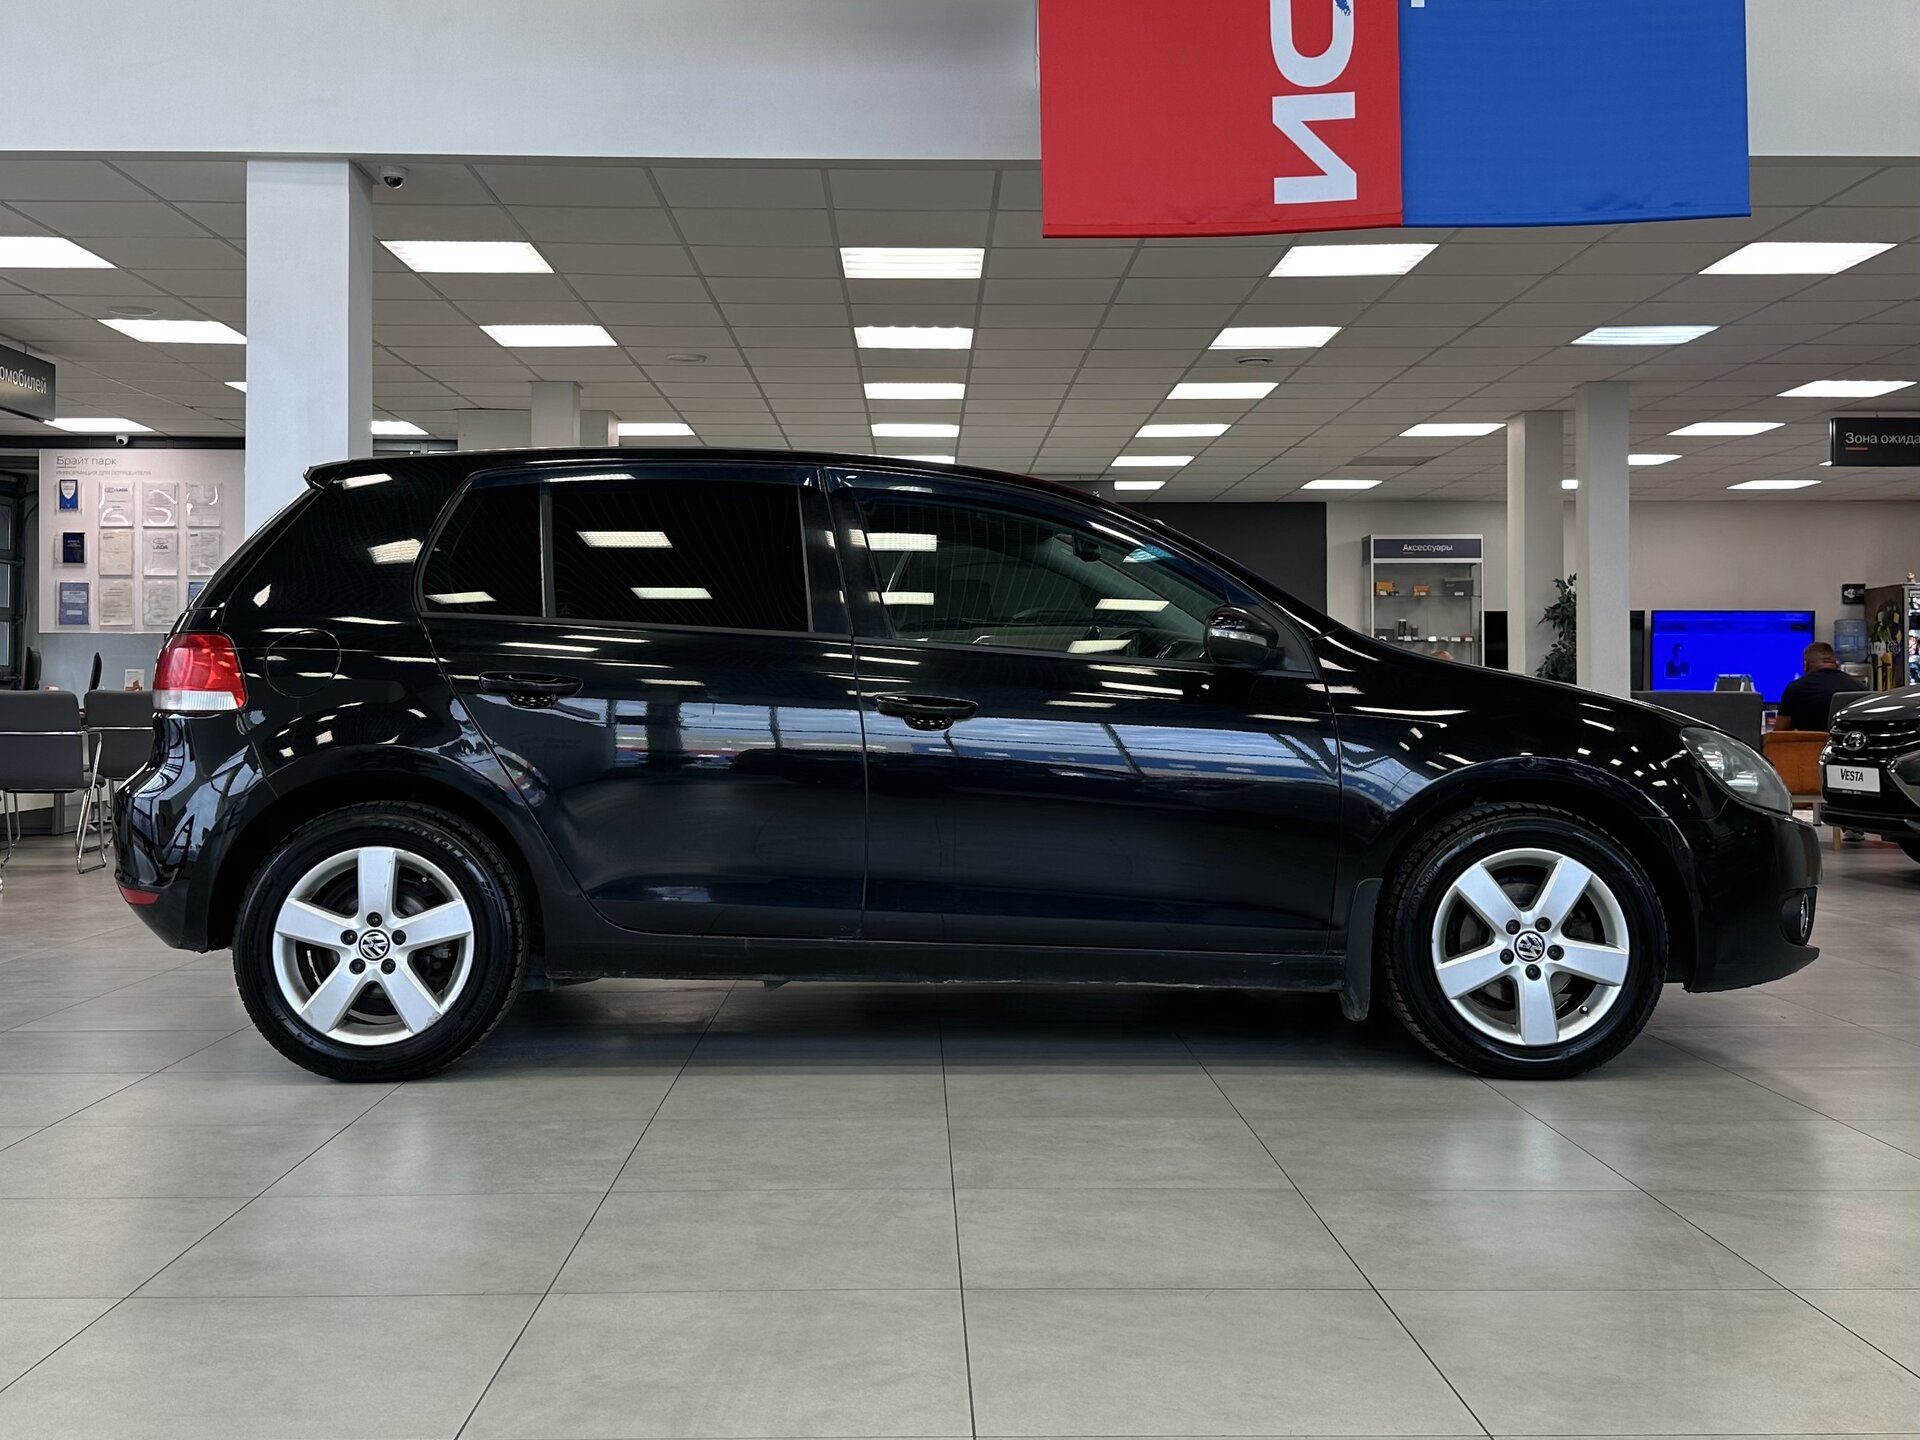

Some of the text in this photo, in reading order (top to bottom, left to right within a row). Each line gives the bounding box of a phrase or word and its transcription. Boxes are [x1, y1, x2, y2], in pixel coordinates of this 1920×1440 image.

[1845, 432, 1920, 446] Зона ожида
[56, 456, 117, 467] Брайт парк
[1402, 543, 1454, 553] Аксессуары
[1840, 768, 1864, 782] VESTA
